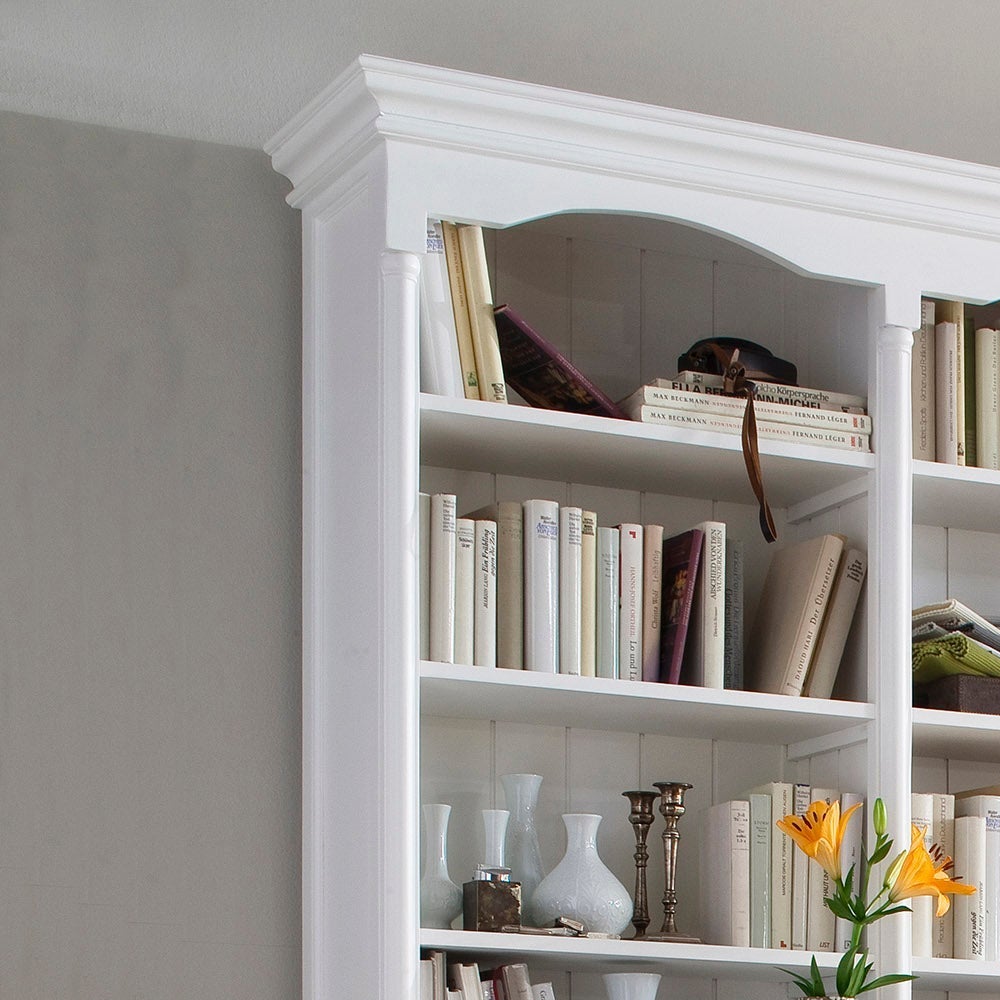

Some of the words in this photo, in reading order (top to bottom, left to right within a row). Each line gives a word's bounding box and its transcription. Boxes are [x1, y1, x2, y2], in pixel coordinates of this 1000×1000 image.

[757, 384, 776, 394] olcho
[776, 386, 830, 402] Körpersprache
[671, 396, 710, 406] BECKMANN
[669, 414, 707, 425] BECKMANN
[794, 412, 826, 421] FERNAND
[828, 415, 848, 424] LÉGER
[792, 431, 823, 440] FERNAND
[825, 434, 846, 443] LÉGER
[810, 609, 820, 626] Der
[815, 558, 835, 606] Übersetzer
[795, 652, 807, 681] DAOUD
[804, 630, 813, 652] HARI
